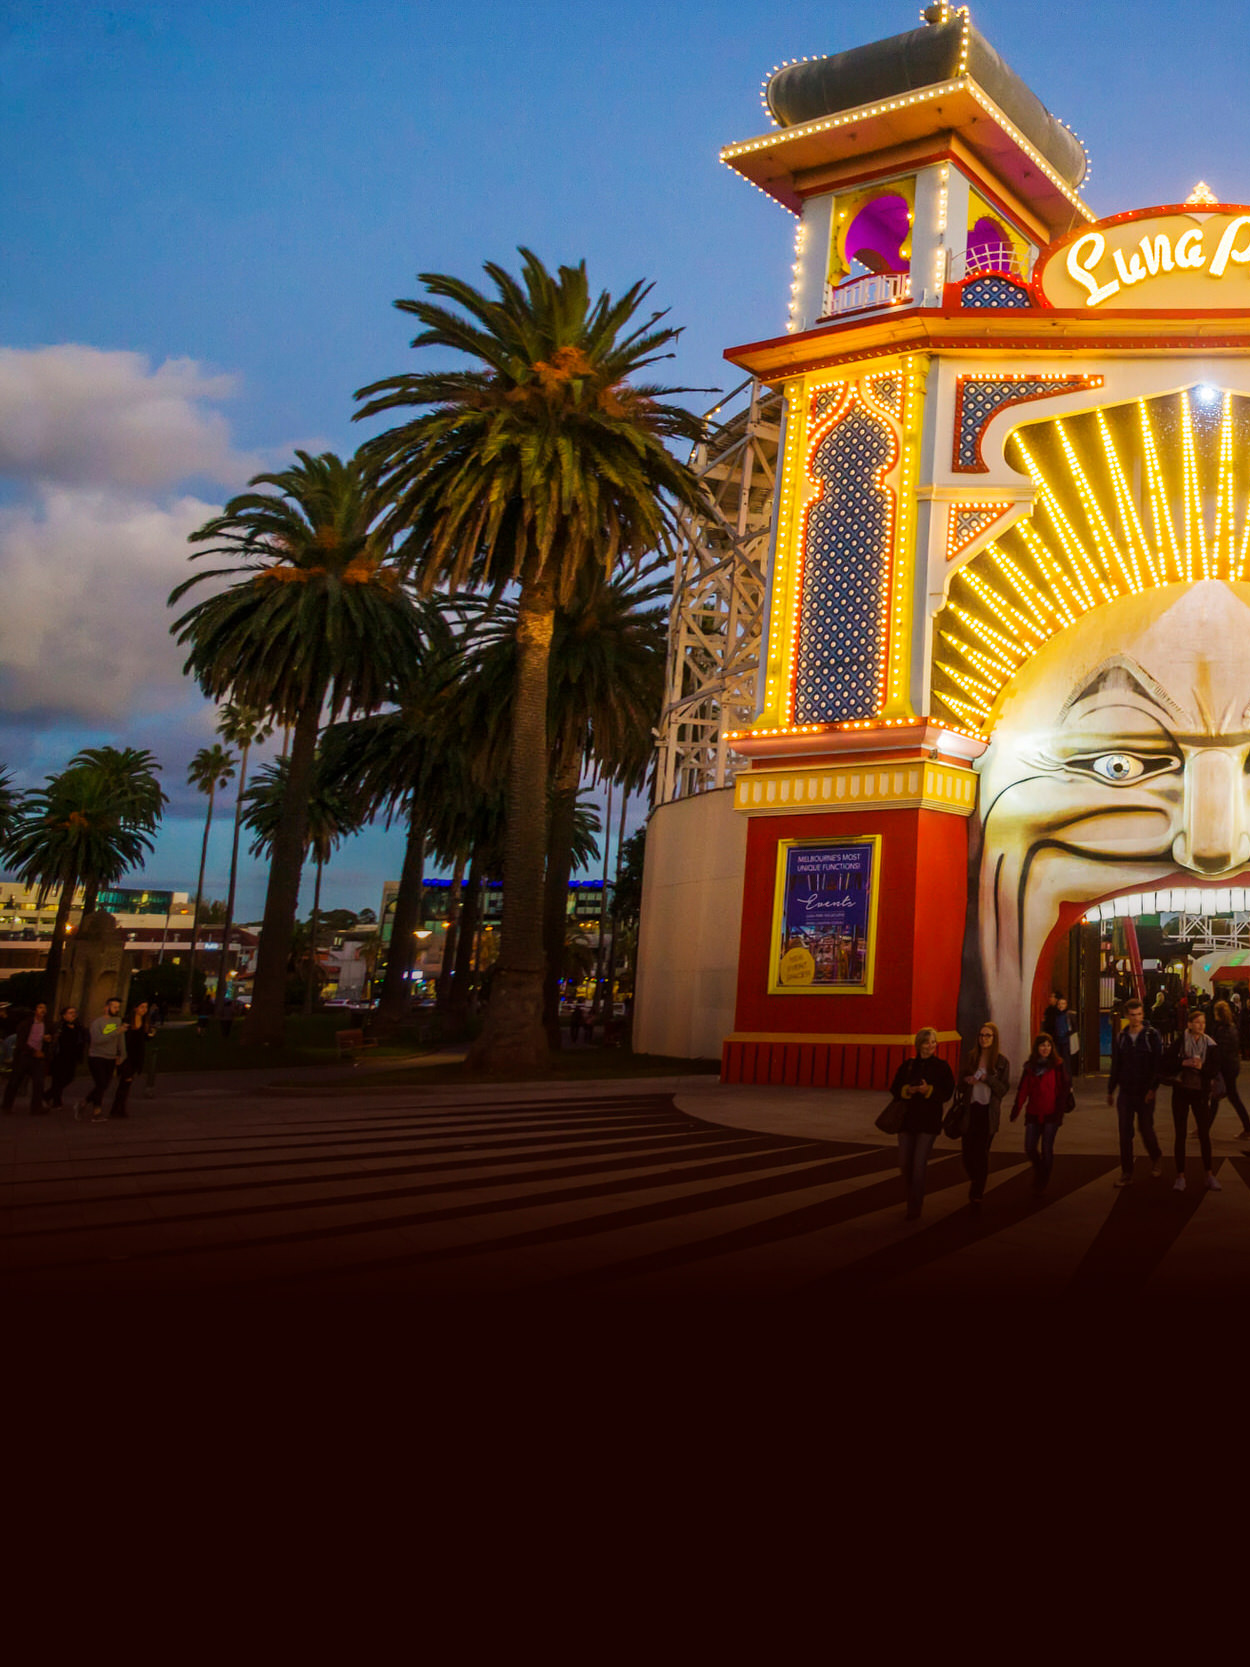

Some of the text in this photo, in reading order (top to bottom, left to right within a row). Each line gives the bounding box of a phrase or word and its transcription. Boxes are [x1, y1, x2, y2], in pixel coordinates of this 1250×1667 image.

[1066, 229, 1207, 308] Luna
[842, 853, 861, 861] MOST
[796, 893, 857, 911] Events
